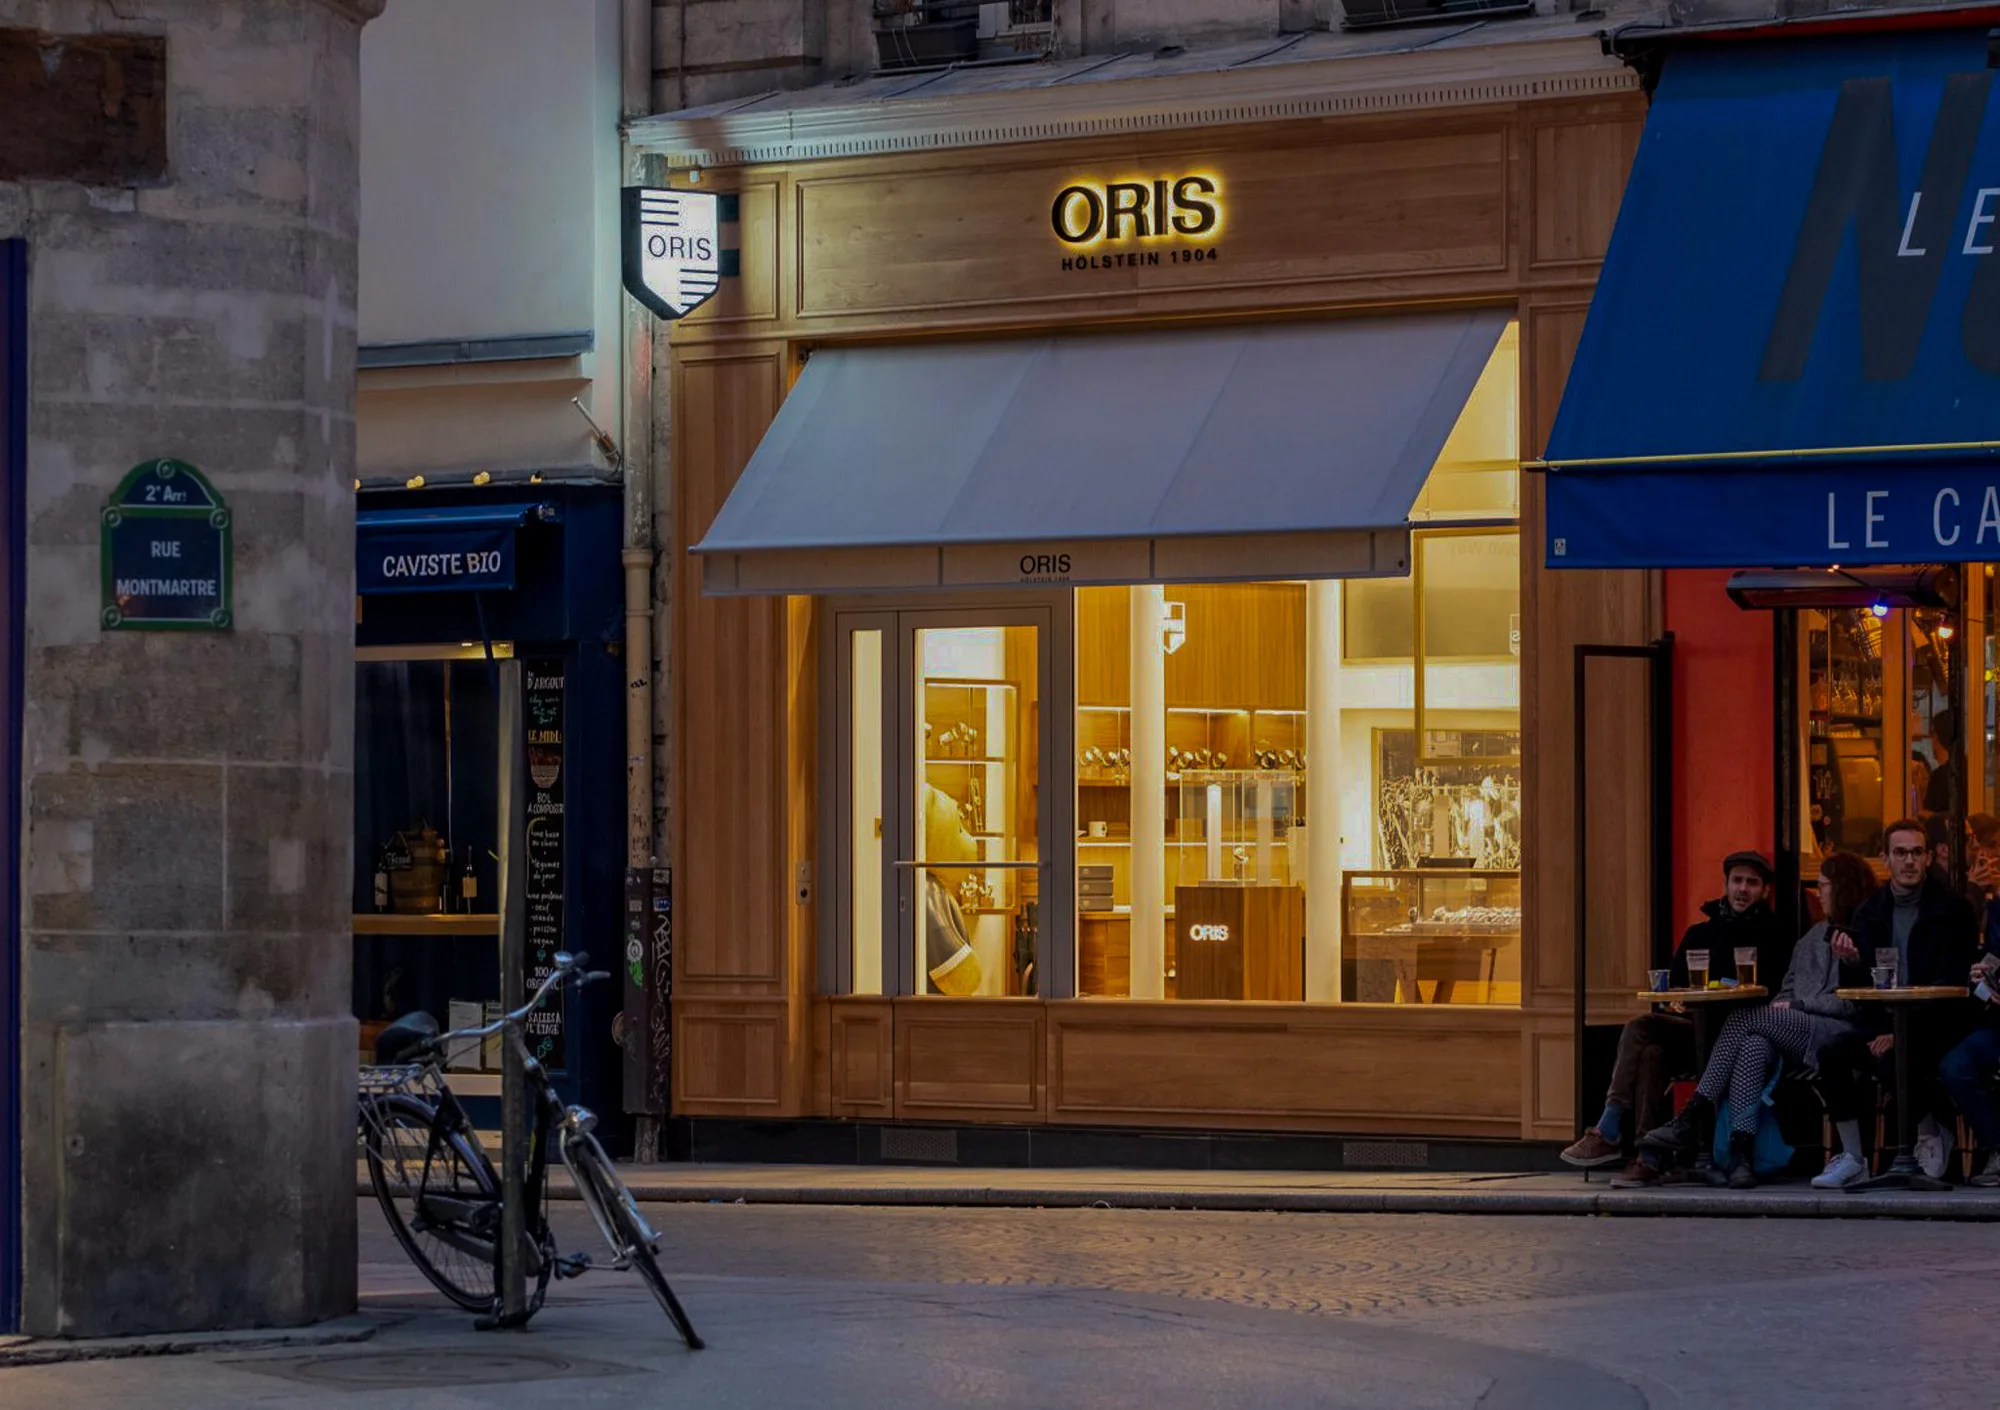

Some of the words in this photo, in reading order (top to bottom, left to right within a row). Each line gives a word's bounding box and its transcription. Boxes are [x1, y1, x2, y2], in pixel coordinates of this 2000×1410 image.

[1052, 176, 1216, 243] ORIS
[1897, 187, 2000, 256] LE
[648, 234, 712, 261] ORIS
[1062, 251, 1160, 271] HÖLSTEIN
[1170, 247, 1218, 264] 1904
[1827, 490, 1889, 550] LE
[1933, 485, 2000, 547] CA
[151, 540, 182, 558] RUE
[382, 552, 464, 578] CAVISTE
[466, 550, 502, 575] BIO
[1020, 553, 1071, 574] ORIS
[116, 578, 217, 597] MONTMARTRE
